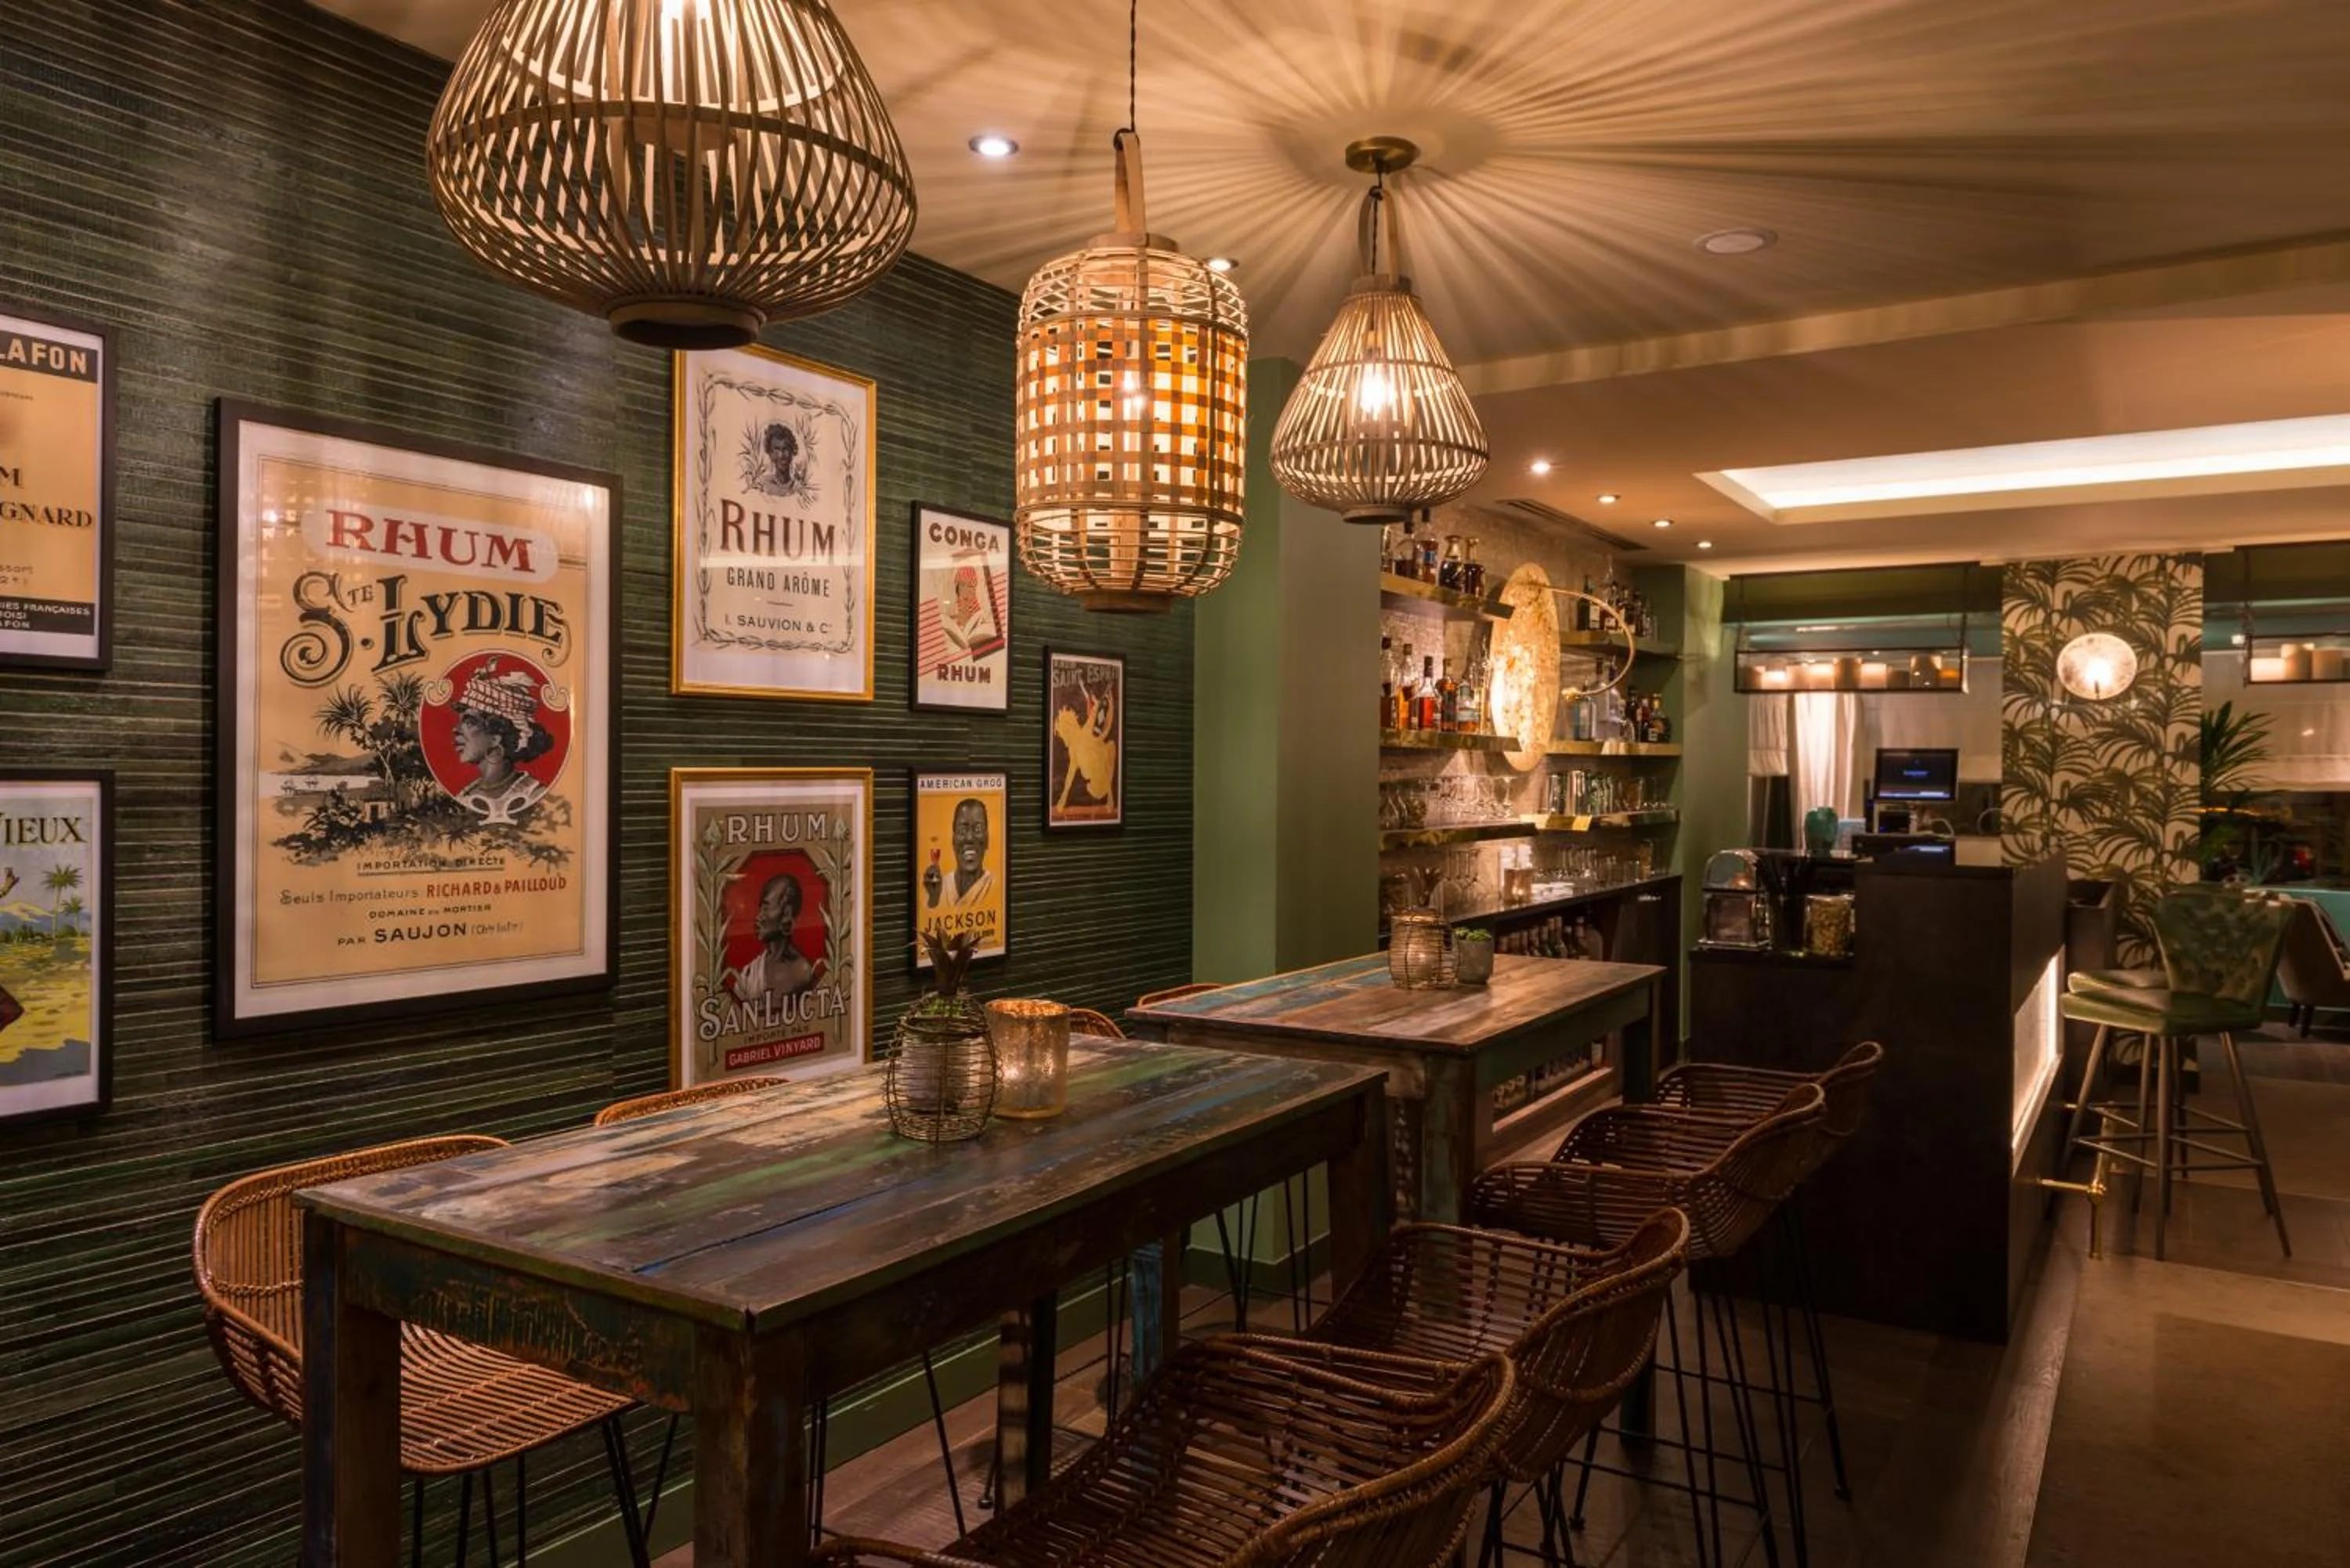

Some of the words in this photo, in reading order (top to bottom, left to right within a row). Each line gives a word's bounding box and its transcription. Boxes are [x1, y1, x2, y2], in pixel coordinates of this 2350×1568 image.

[324, 508, 536, 574] RHUM
[720, 499, 837, 565] RHUM
[928, 522, 1001, 553] CONGA
[727, 566, 776, 591] GRAND
[371, 574, 572, 675] LYDIE
[737, 615, 802, 631] SAUVION
[806, 620, 815, 633] &
[937, 663, 992, 684] RHUM
[920, 778, 973, 789] AMERICAN
[0, 812, 88, 845] IEUX
[725, 813, 828, 845] RHUM
[357, 858, 446, 871] IMPORTATION
[280, 890, 324, 905] Seuls
[330, 889, 419, 904] Importateurs
[427, 880, 492, 898] RICHARD
[494, 883, 501, 894] &
[504, 876, 567, 892] PAILLOUD
[369, 908, 425, 919] DOMAINE
[925, 909, 996, 933] JACKSON
[338, 936, 367, 946] PAR
[374, 922, 467, 943] SAUJON
[729, 1047, 772, 1066] GABRIEL
[774, 1035, 821, 1057] VINYARD
